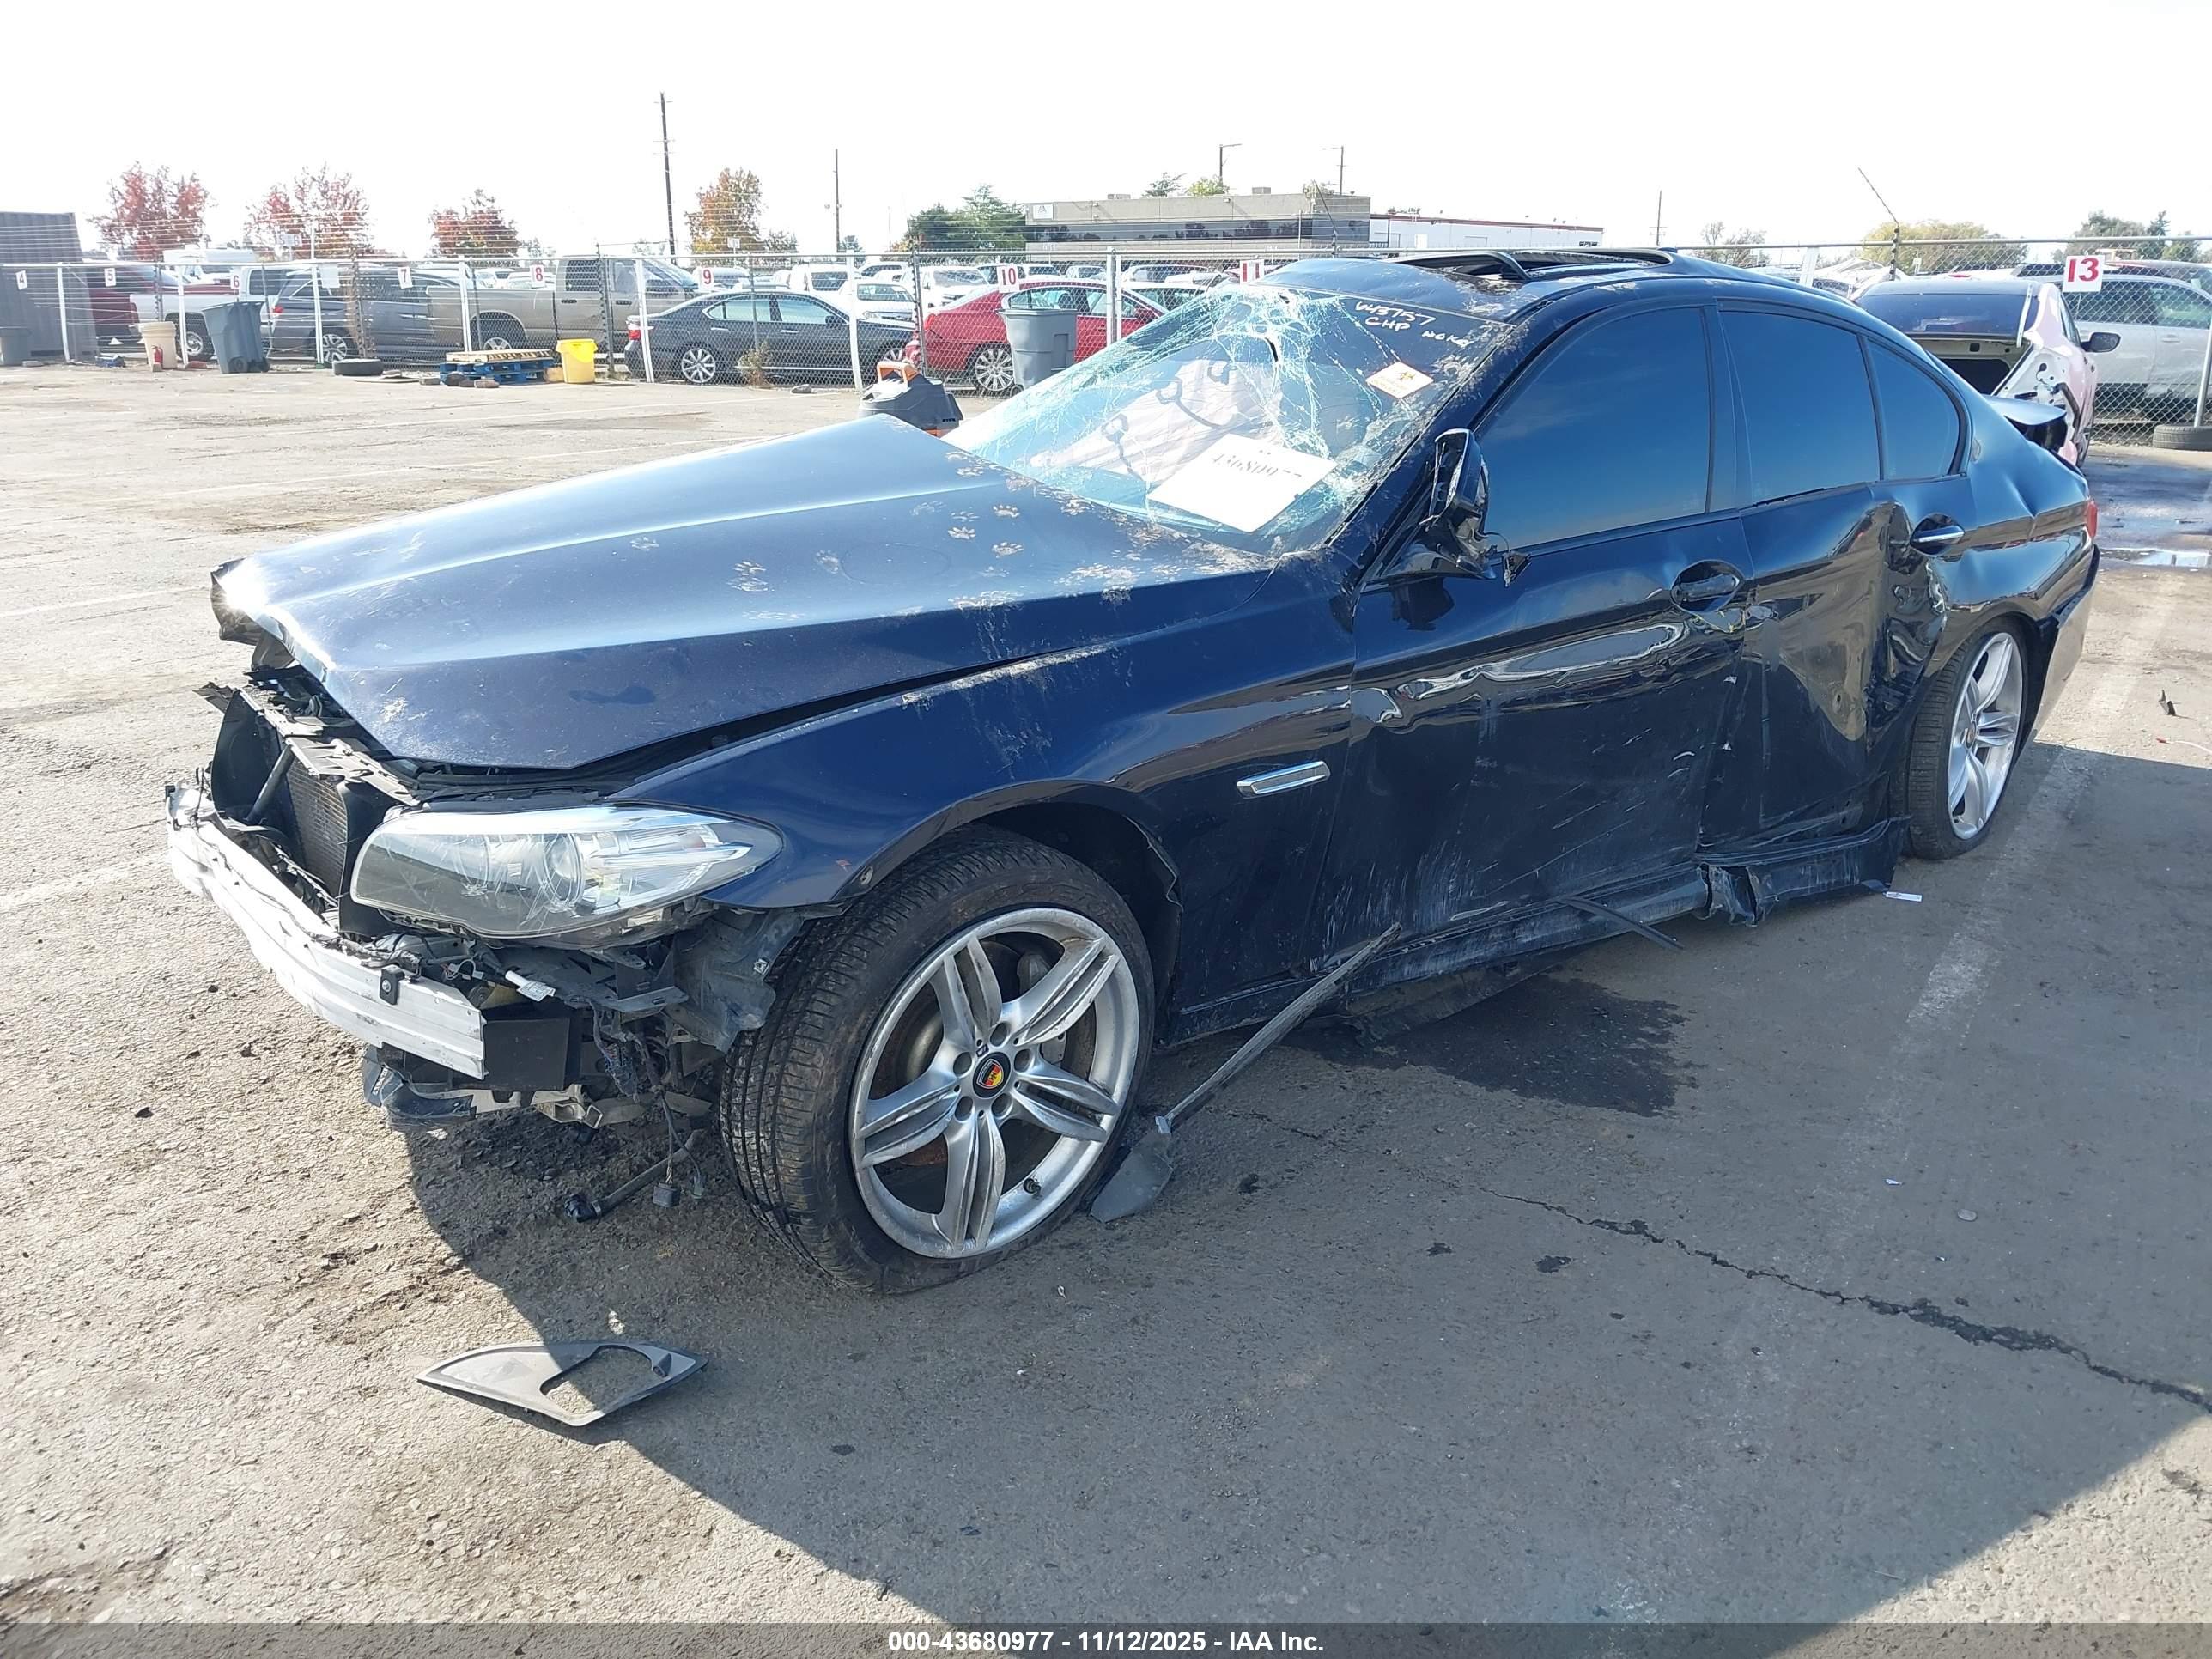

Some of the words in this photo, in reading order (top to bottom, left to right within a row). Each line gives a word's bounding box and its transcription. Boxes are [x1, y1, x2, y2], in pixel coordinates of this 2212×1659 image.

[19, 273, 25, 283] 4
[107, 269, 114, 282] 5
[400, 269, 408, 283] 7
[535, 267, 544, 282] 8
[702, 269, 712, 284] 9
[1001, 267, 1016, 286] 10
[1242, 262, 1261, 283] 11
[2067, 258, 2100, 283] 13
[233, 275, 240, 288] 6
[1364, 315, 1411, 332] CHP
